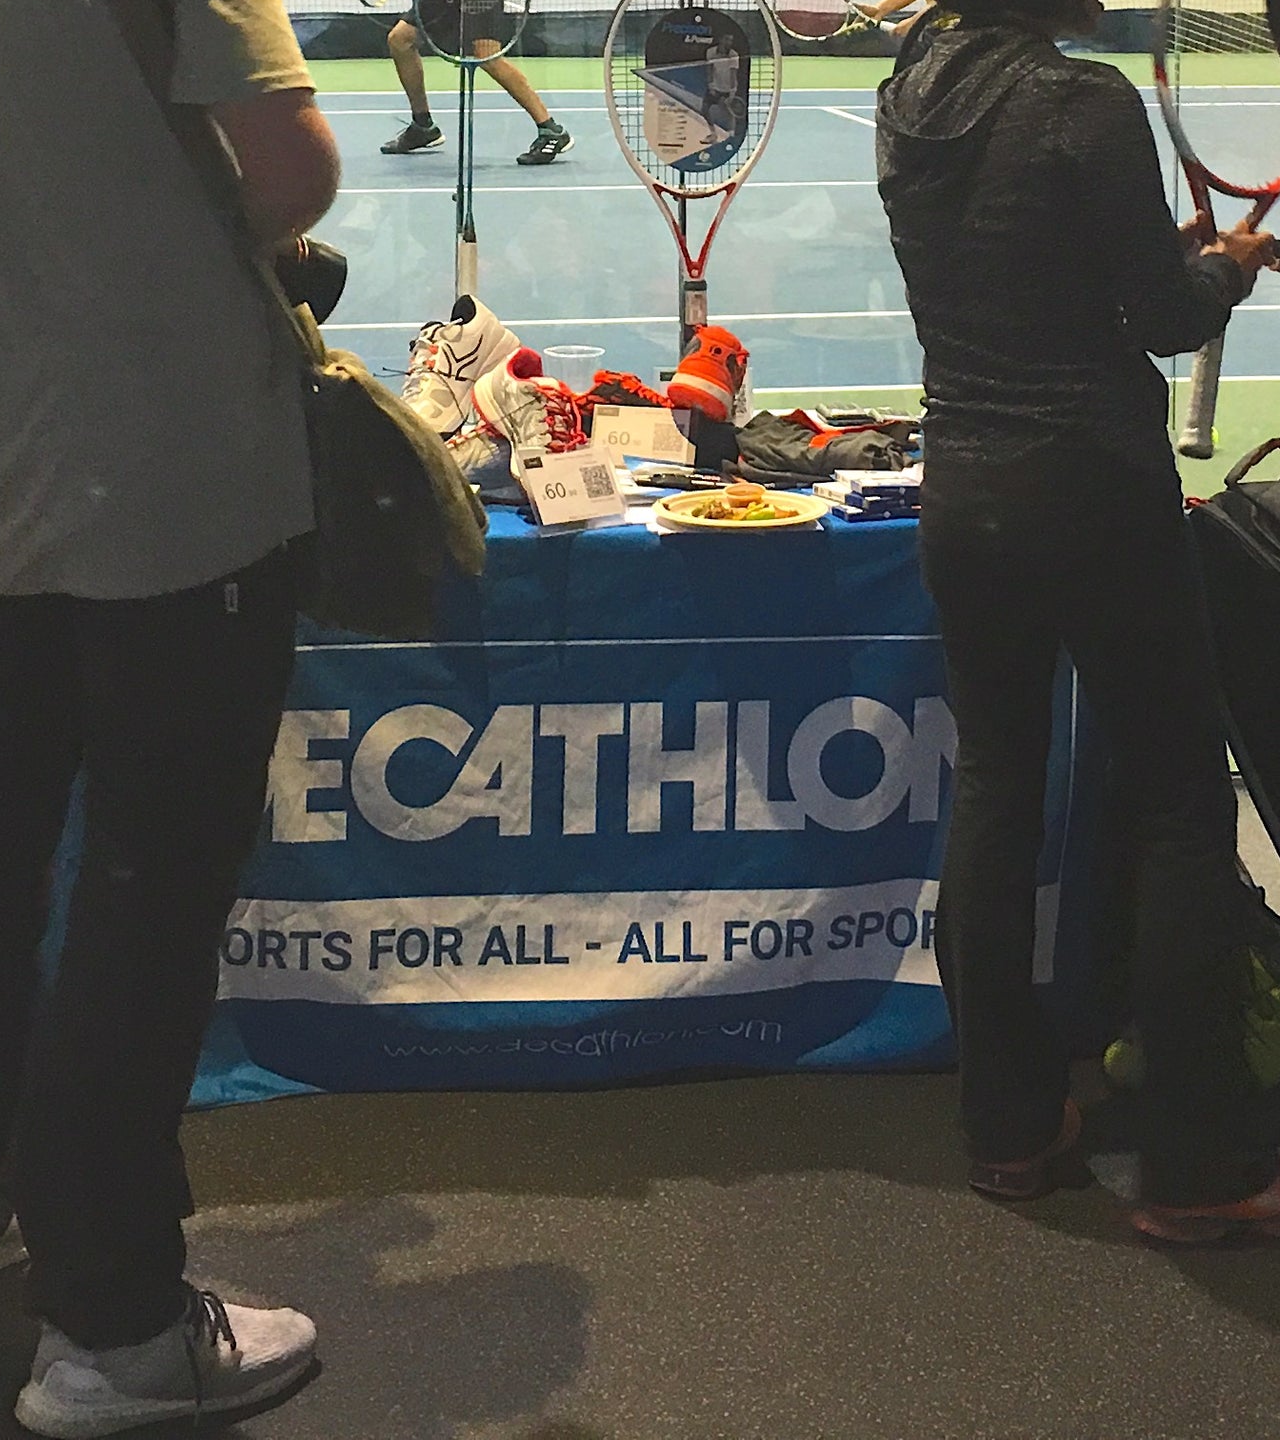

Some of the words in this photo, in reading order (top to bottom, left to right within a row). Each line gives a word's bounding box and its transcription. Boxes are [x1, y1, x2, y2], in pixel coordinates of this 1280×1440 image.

[607, 430, 631, 446] 60
[544, 482, 567, 500] 60
[264, 696, 959, 843] ECATHLO
[367, 926, 463, 971] FOR
[477, 923, 570, 967] ALL
[617, 919, 708, 964] ALL
[723, 916, 814, 960] FOR
